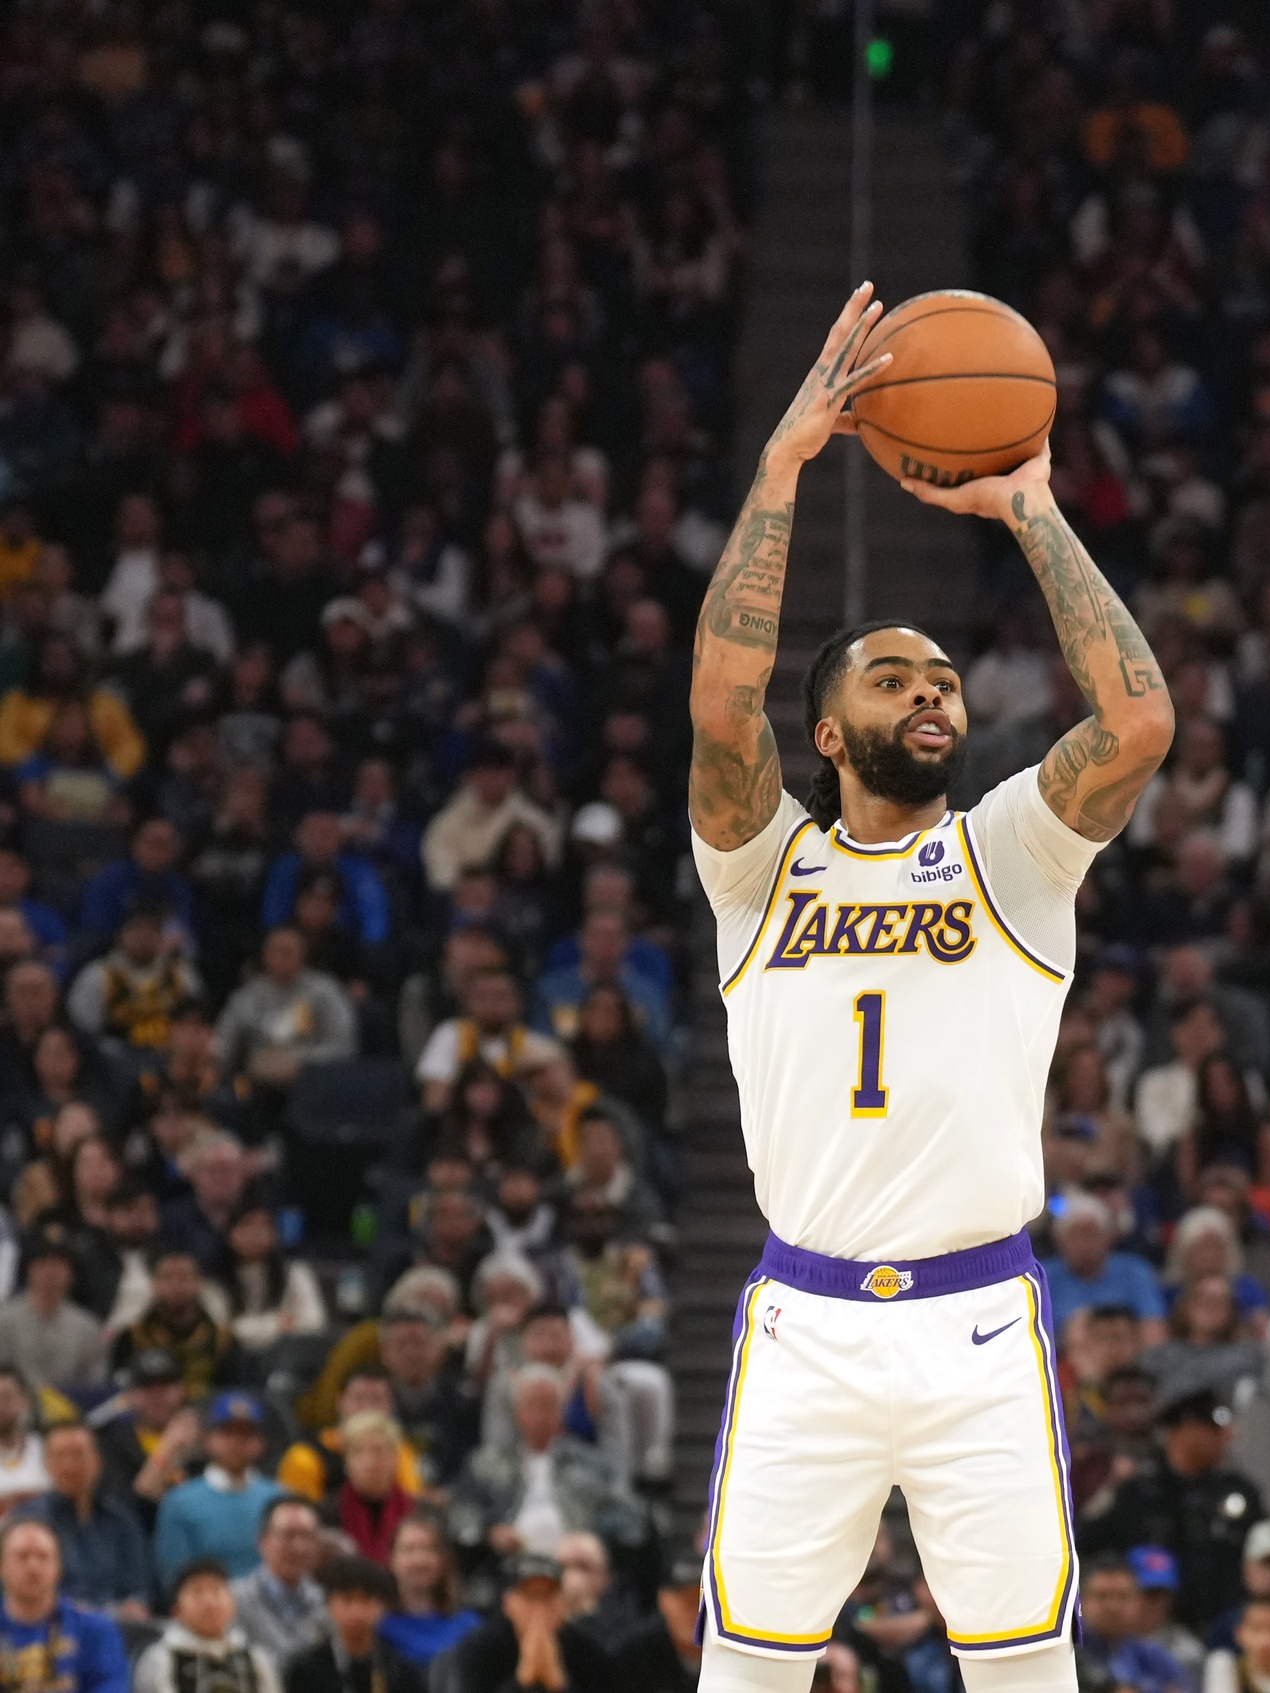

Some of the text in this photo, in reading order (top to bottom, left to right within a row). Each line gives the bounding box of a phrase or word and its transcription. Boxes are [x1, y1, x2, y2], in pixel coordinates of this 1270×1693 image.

[911, 863, 963, 883] bibigo
[764, 889, 978, 972] LAKERS
[850, 989, 890, 1119] 1
[863, 1274, 912, 1290] LAKERS
